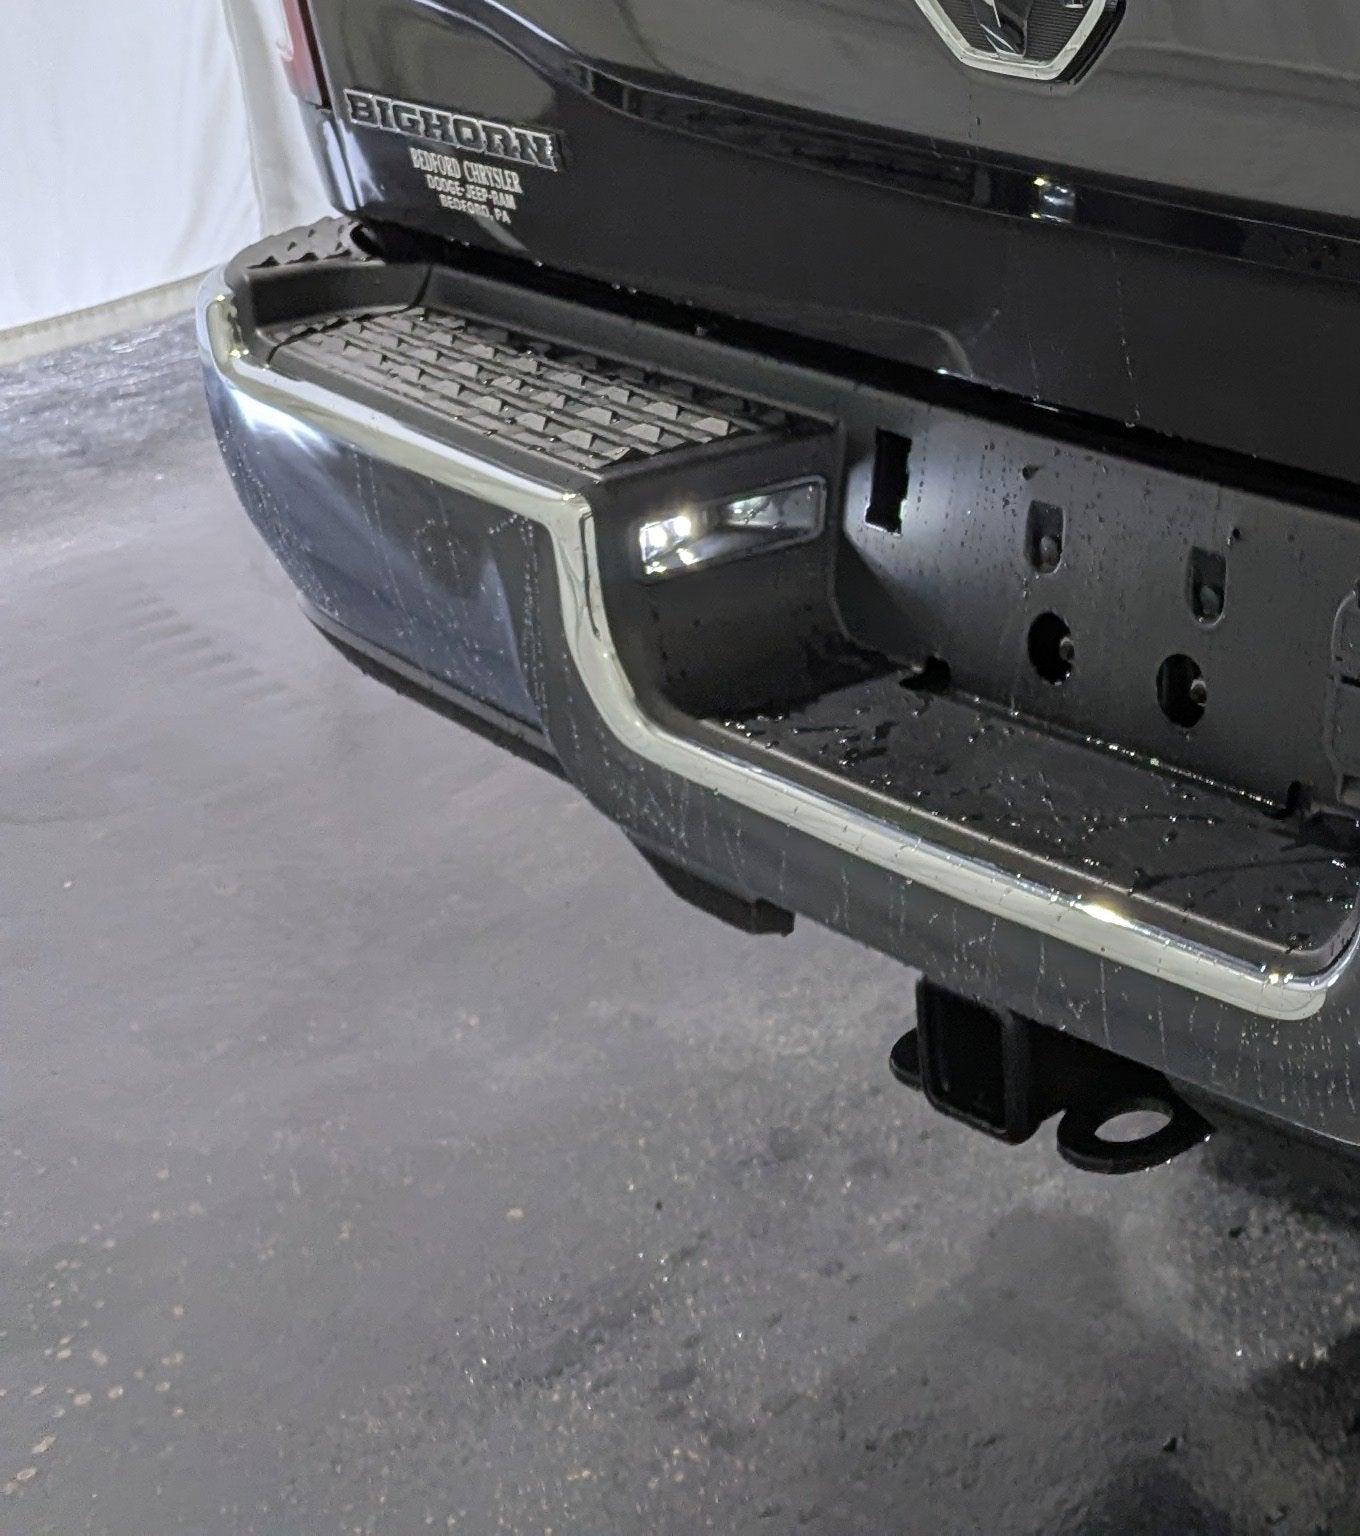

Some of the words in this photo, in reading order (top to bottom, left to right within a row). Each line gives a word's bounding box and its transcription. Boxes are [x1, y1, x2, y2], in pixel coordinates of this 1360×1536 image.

[409, 147, 462, 179] BEDFORD
[462, 160, 524, 194] CHRYSLER
[493, 207, 512, 224] PA
